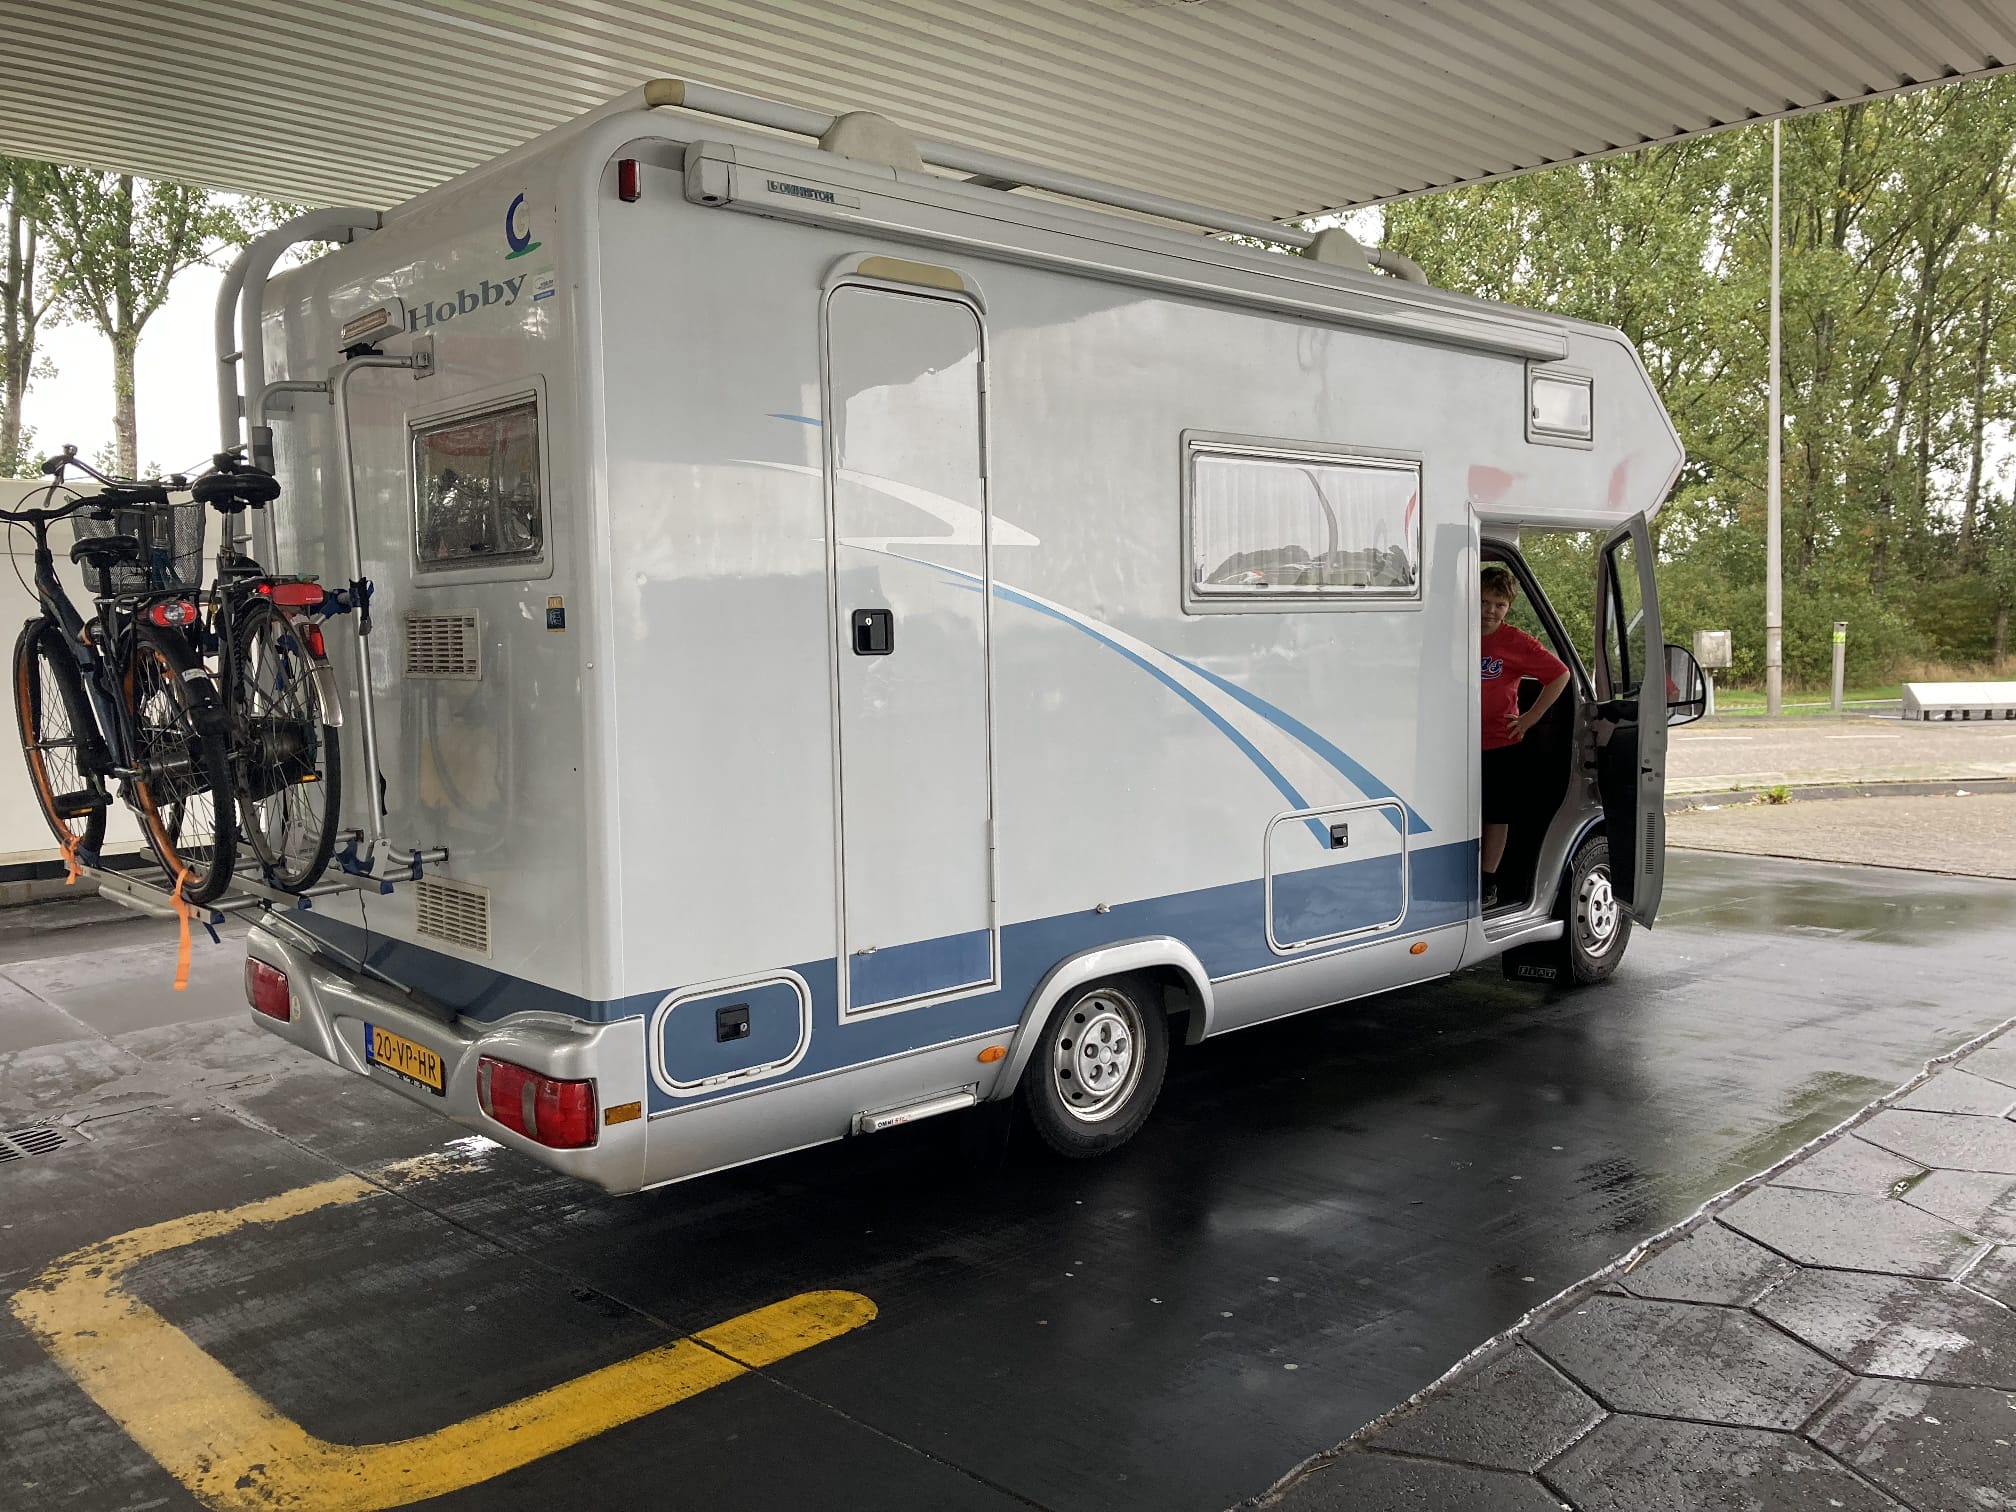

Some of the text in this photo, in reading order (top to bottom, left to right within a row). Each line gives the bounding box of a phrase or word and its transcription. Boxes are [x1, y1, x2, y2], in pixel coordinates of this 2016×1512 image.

[408, 273, 527, 334] Hobby
[1520, 967, 1555, 978] FIAT
[376, 1032, 437, 1081] 20-VP-HR
